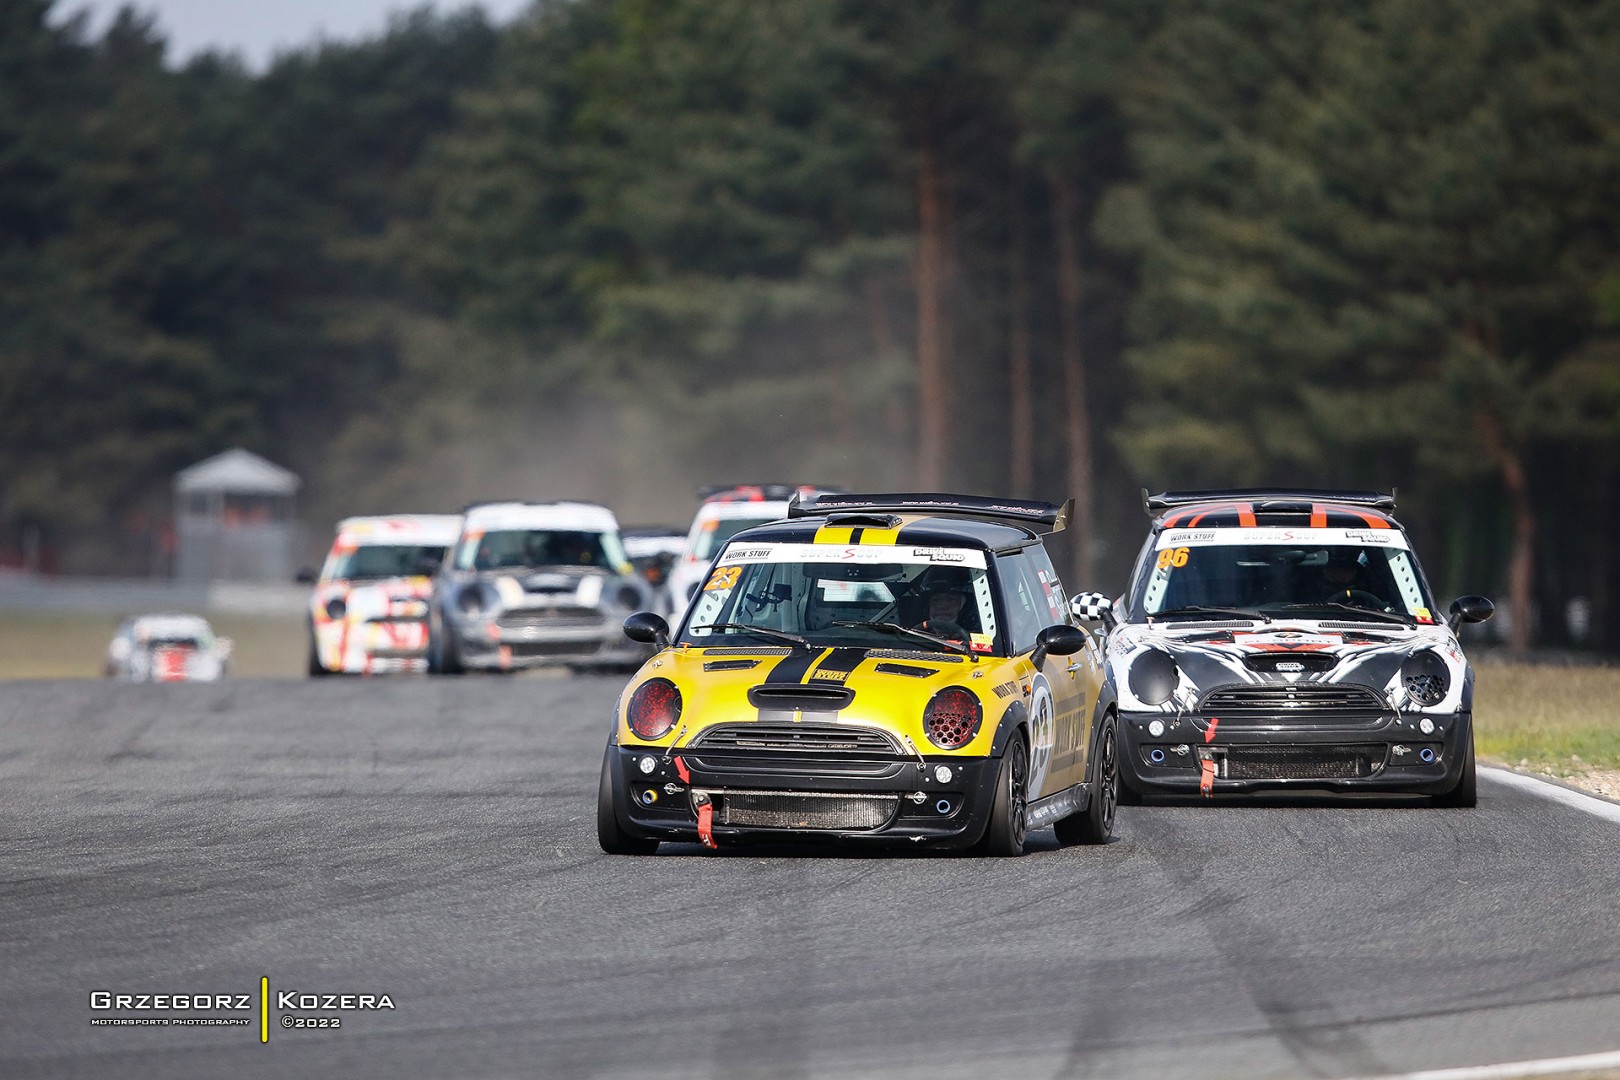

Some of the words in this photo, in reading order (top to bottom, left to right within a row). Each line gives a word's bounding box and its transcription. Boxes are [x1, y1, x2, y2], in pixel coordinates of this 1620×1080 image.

[725, 551, 747, 559] WORK
[1157, 546, 1190, 569] 96
[703, 566, 742, 591] 23
